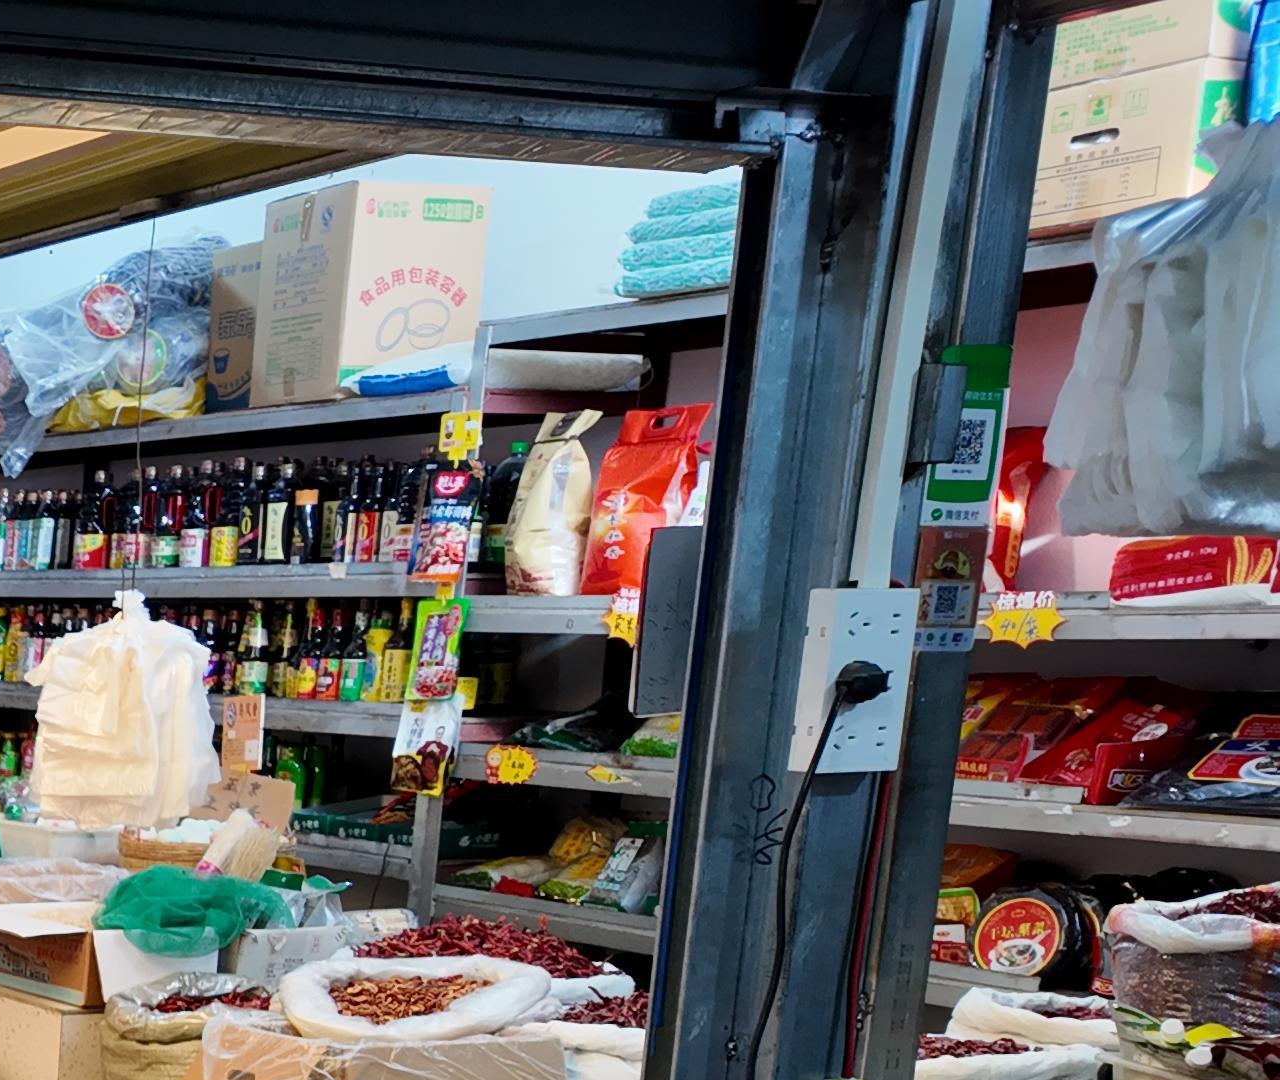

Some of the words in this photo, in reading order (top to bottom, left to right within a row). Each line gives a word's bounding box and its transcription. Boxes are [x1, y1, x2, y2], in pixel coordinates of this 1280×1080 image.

[359, 266, 468, 308] 食品用包装容器
[945, 509, 979, 521] 微信支付
[996, 590, 1056, 610] 惊爆价
